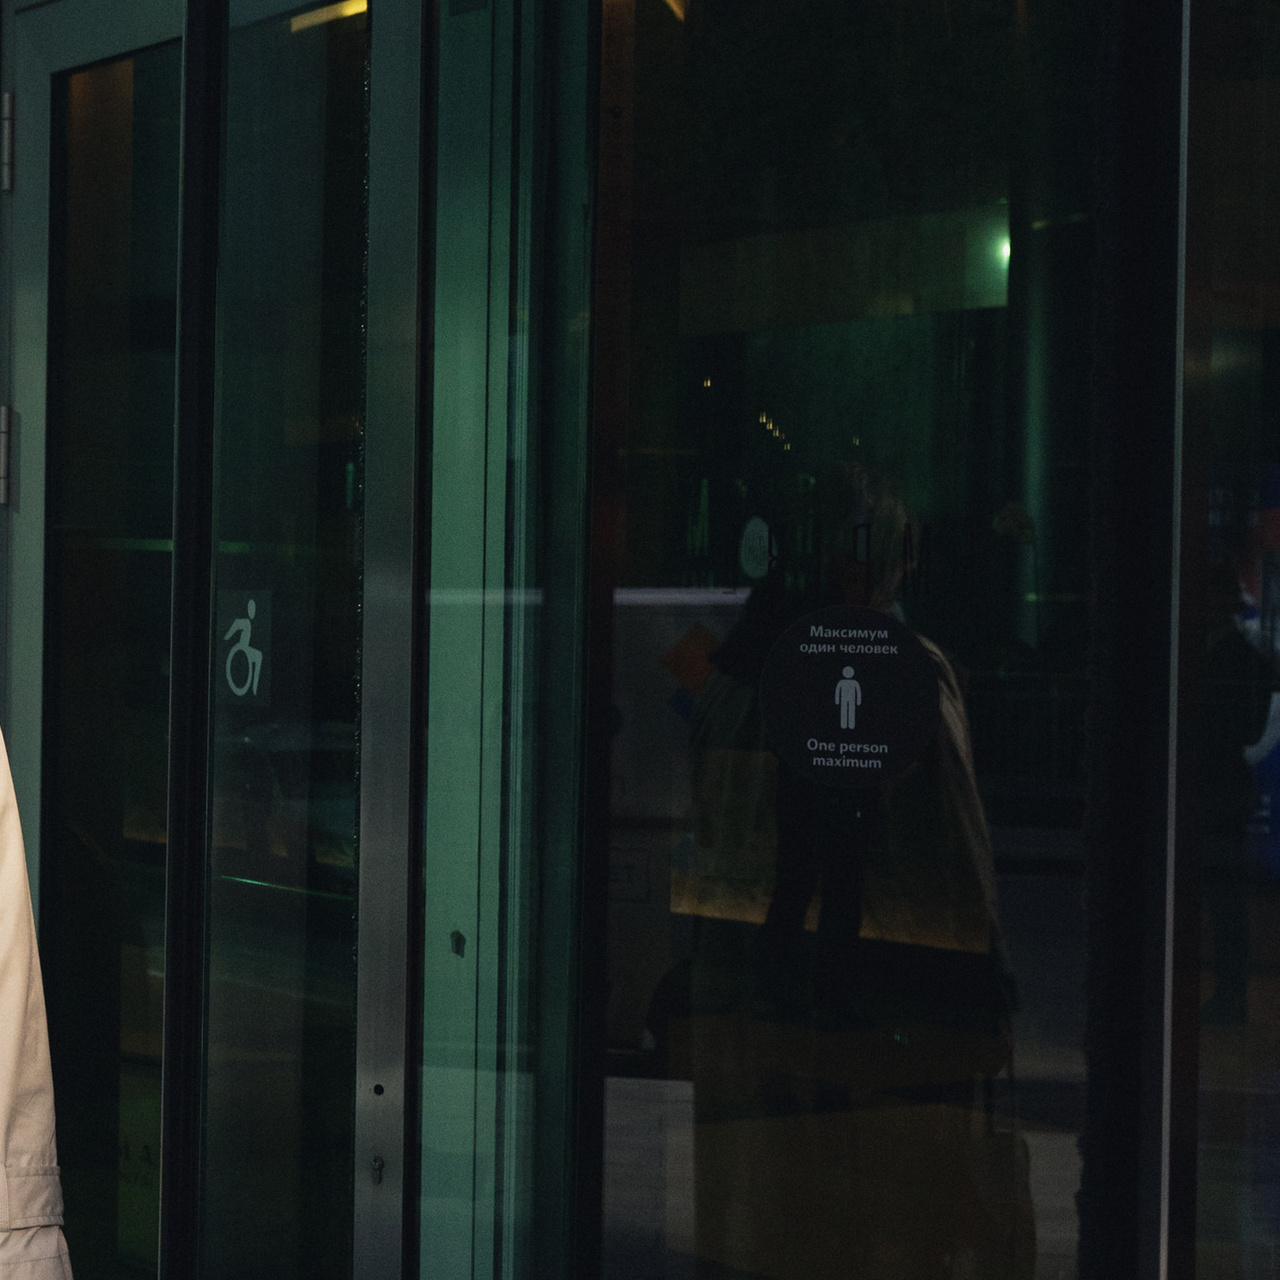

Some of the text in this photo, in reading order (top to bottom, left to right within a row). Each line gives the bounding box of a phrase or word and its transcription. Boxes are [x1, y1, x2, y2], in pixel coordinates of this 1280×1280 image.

[810, 625, 889, 641] Максимум
[800, 642, 898, 655] один человек
[807, 738, 889, 754] One person
[813, 755, 882, 769] maximum
